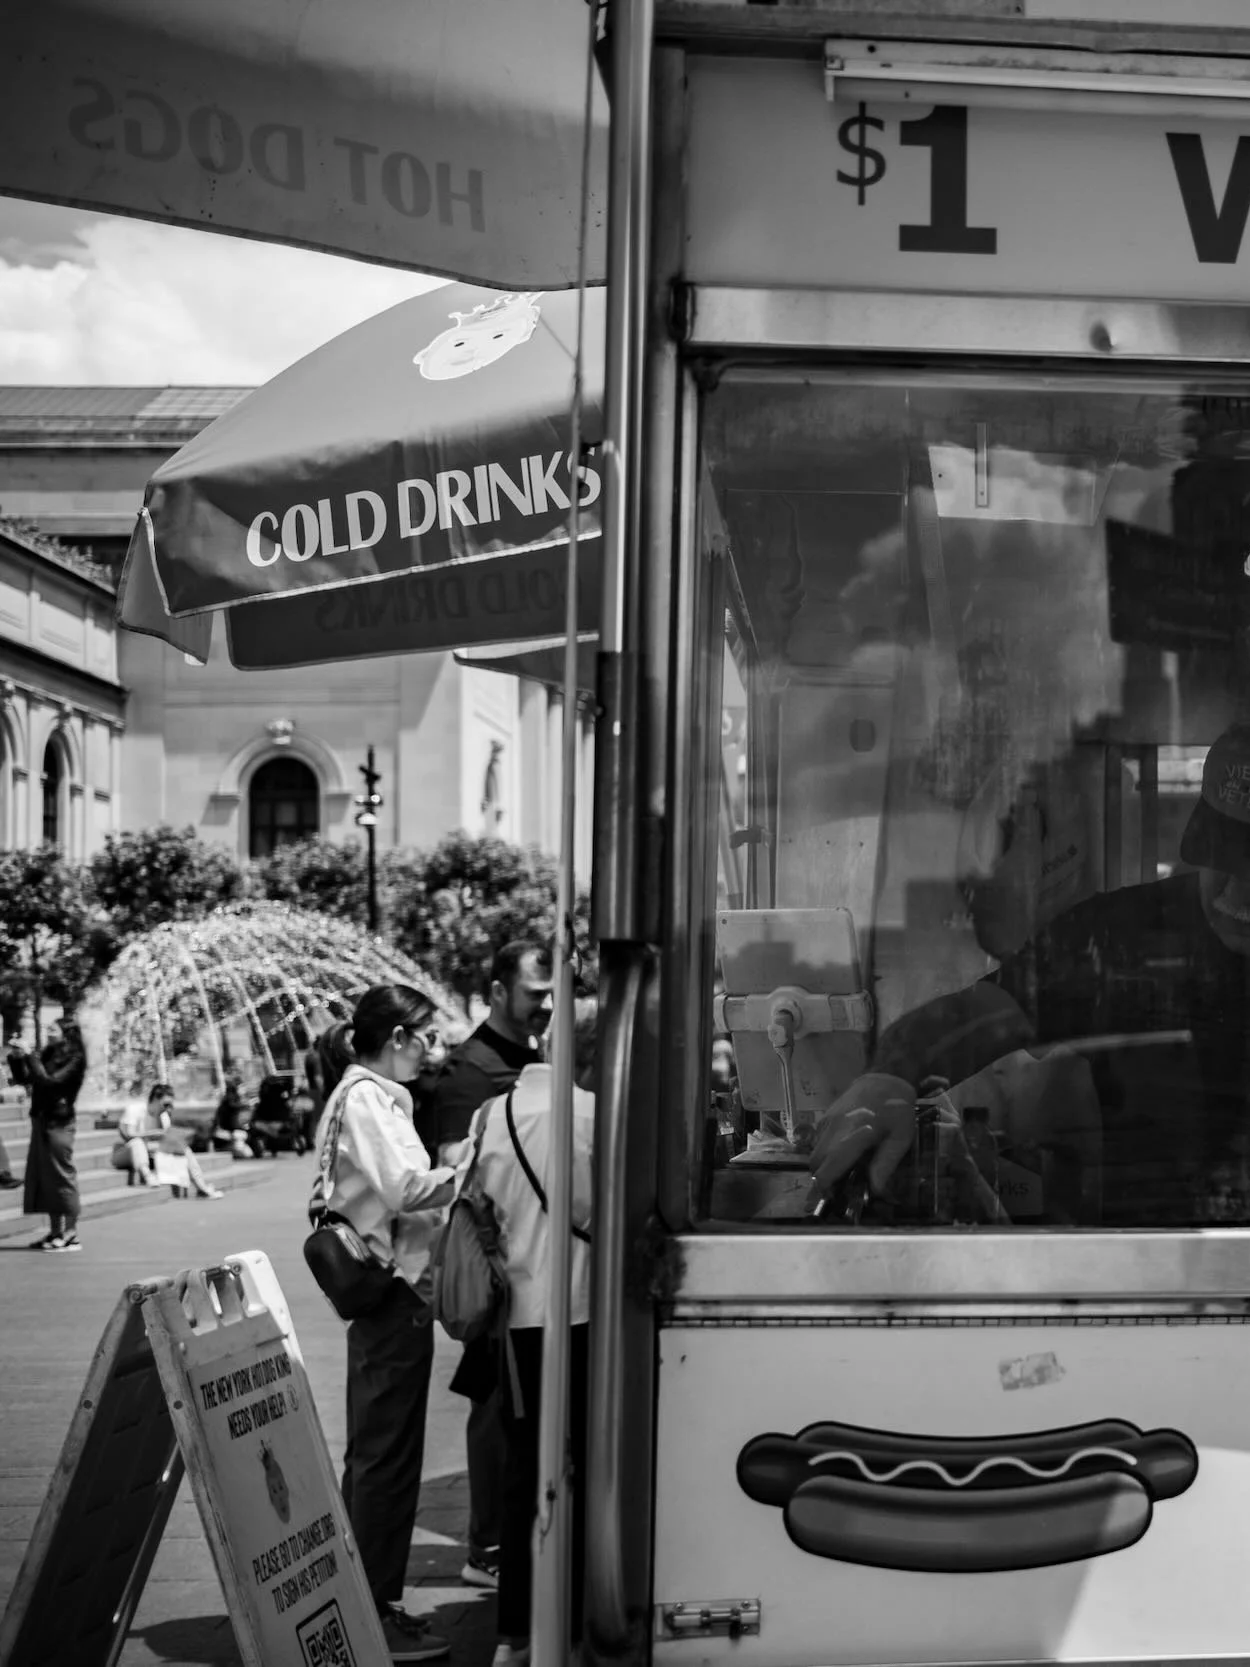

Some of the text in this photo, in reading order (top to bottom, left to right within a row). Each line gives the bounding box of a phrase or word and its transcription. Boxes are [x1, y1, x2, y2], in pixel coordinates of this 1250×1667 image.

[836, 101, 997, 255] $1
[246, 447, 602, 568] COLD DRINKS
[200, 1381, 218, 1411] THE
[216, 1374, 233, 1405] NEW
[232, 1367, 254, 1397] YORK
[273, 1351, 292, 1379] KING
[227, 1406, 252, 1440] NEEDS
[250, 1399, 271, 1429] YOUR
[252, 1546, 282, 1586] PLEASE
[279, 1540, 292, 1569] GO
[288, 1535, 301, 1562] TO
[272, 1586, 285, 1615] TO
[282, 1575, 301, 1608] SIGN
